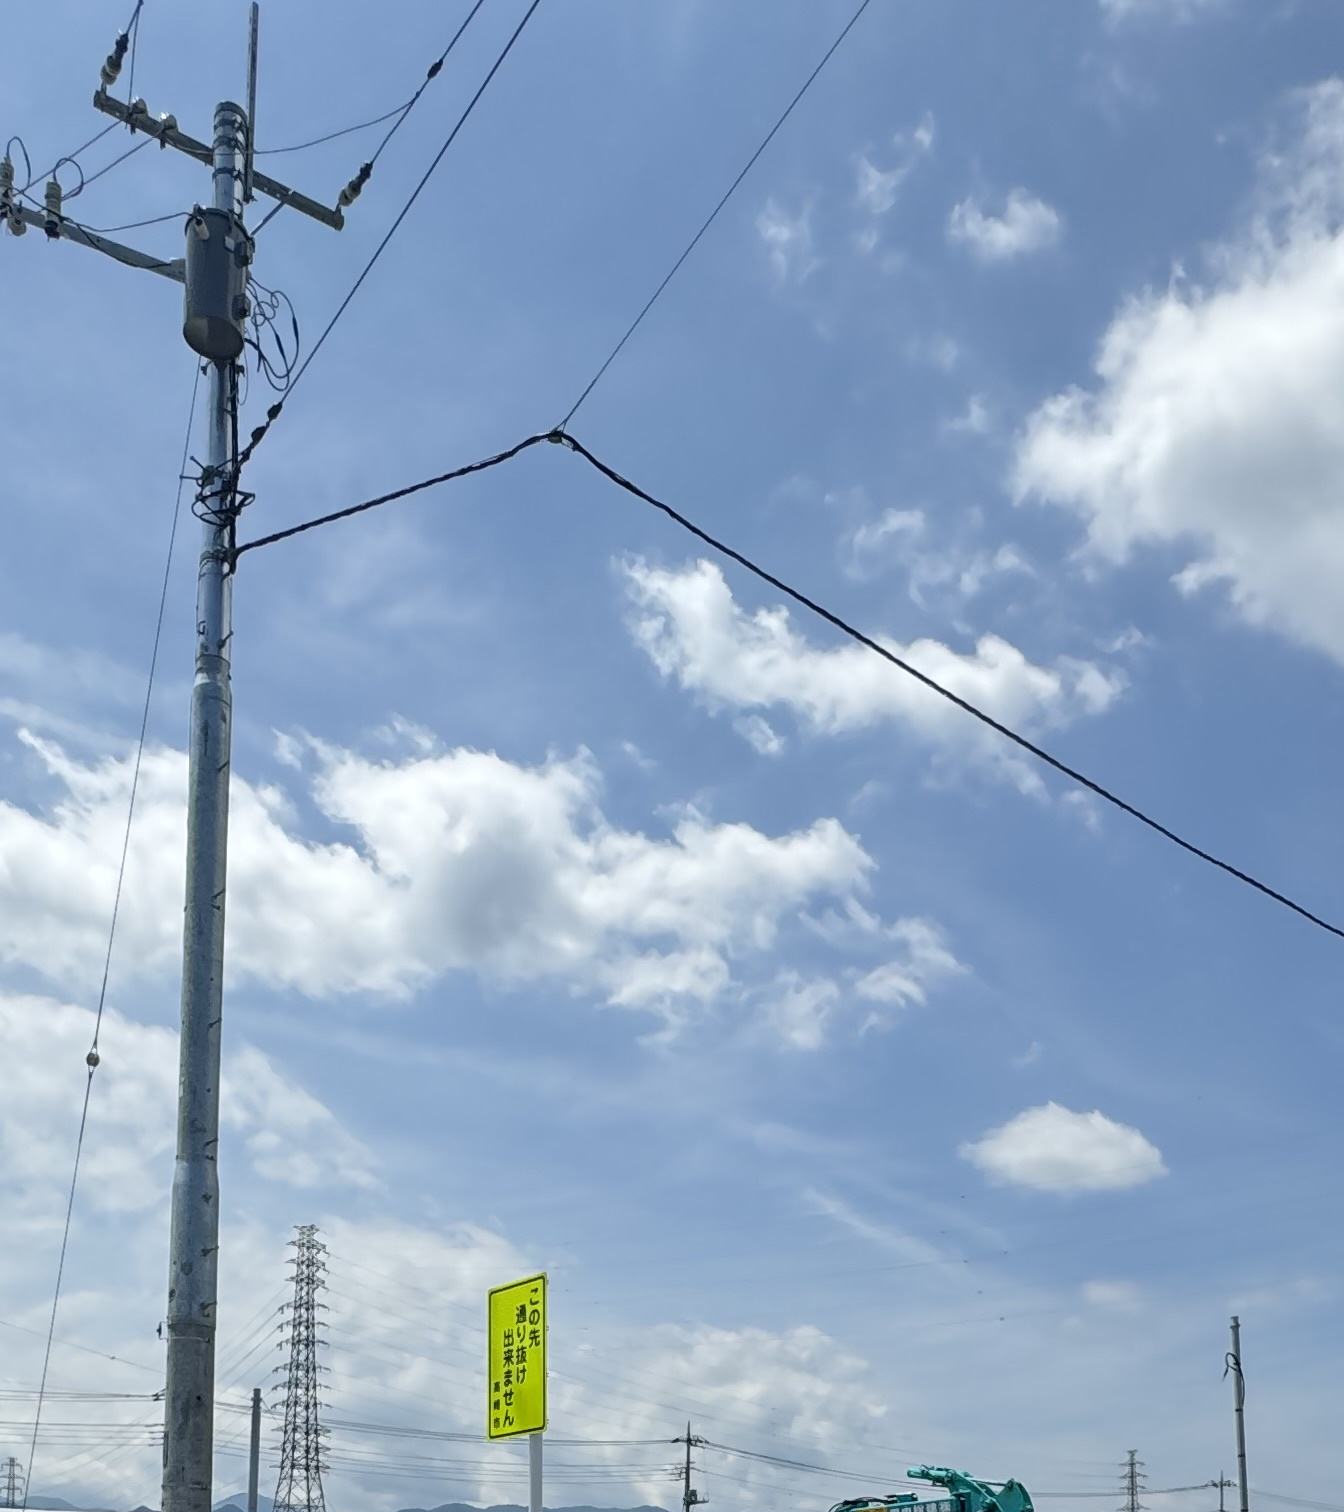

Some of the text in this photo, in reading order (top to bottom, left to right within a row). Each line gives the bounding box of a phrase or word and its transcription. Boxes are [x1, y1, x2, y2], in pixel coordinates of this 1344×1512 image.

[515, 1304, 527, 1384] 通り抜け
[529, 1287, 541, 1348] この先
[503, 1328, 514, 1427] 出来ません
